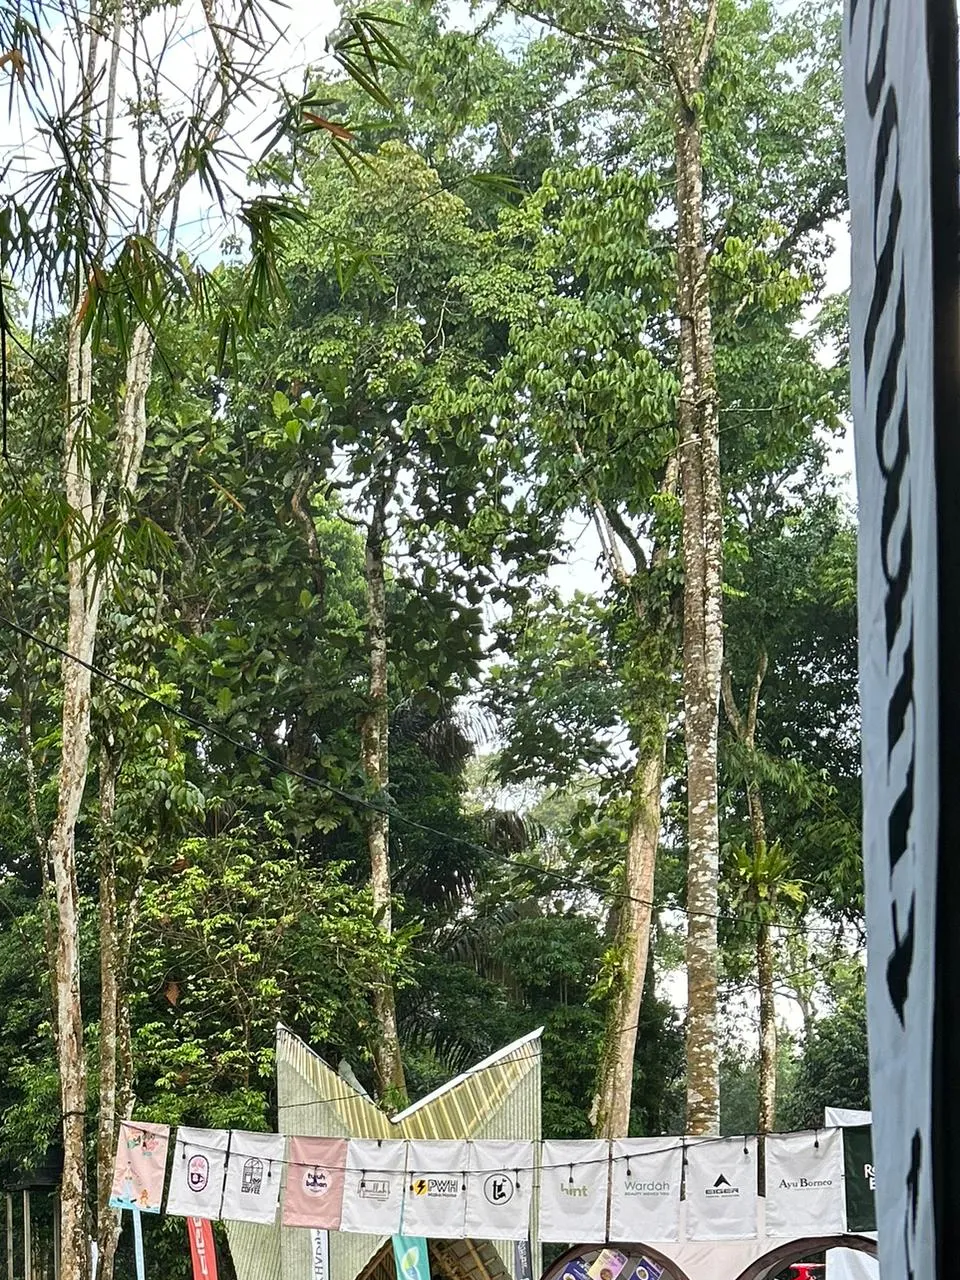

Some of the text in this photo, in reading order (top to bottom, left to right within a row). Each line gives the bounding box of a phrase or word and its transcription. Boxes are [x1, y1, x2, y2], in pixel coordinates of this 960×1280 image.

[624, 1181, 670, 1191] Wardah
[779, 1179, 798, 1189] Ayu
[800, 1178, 833, 1187] Borneo
